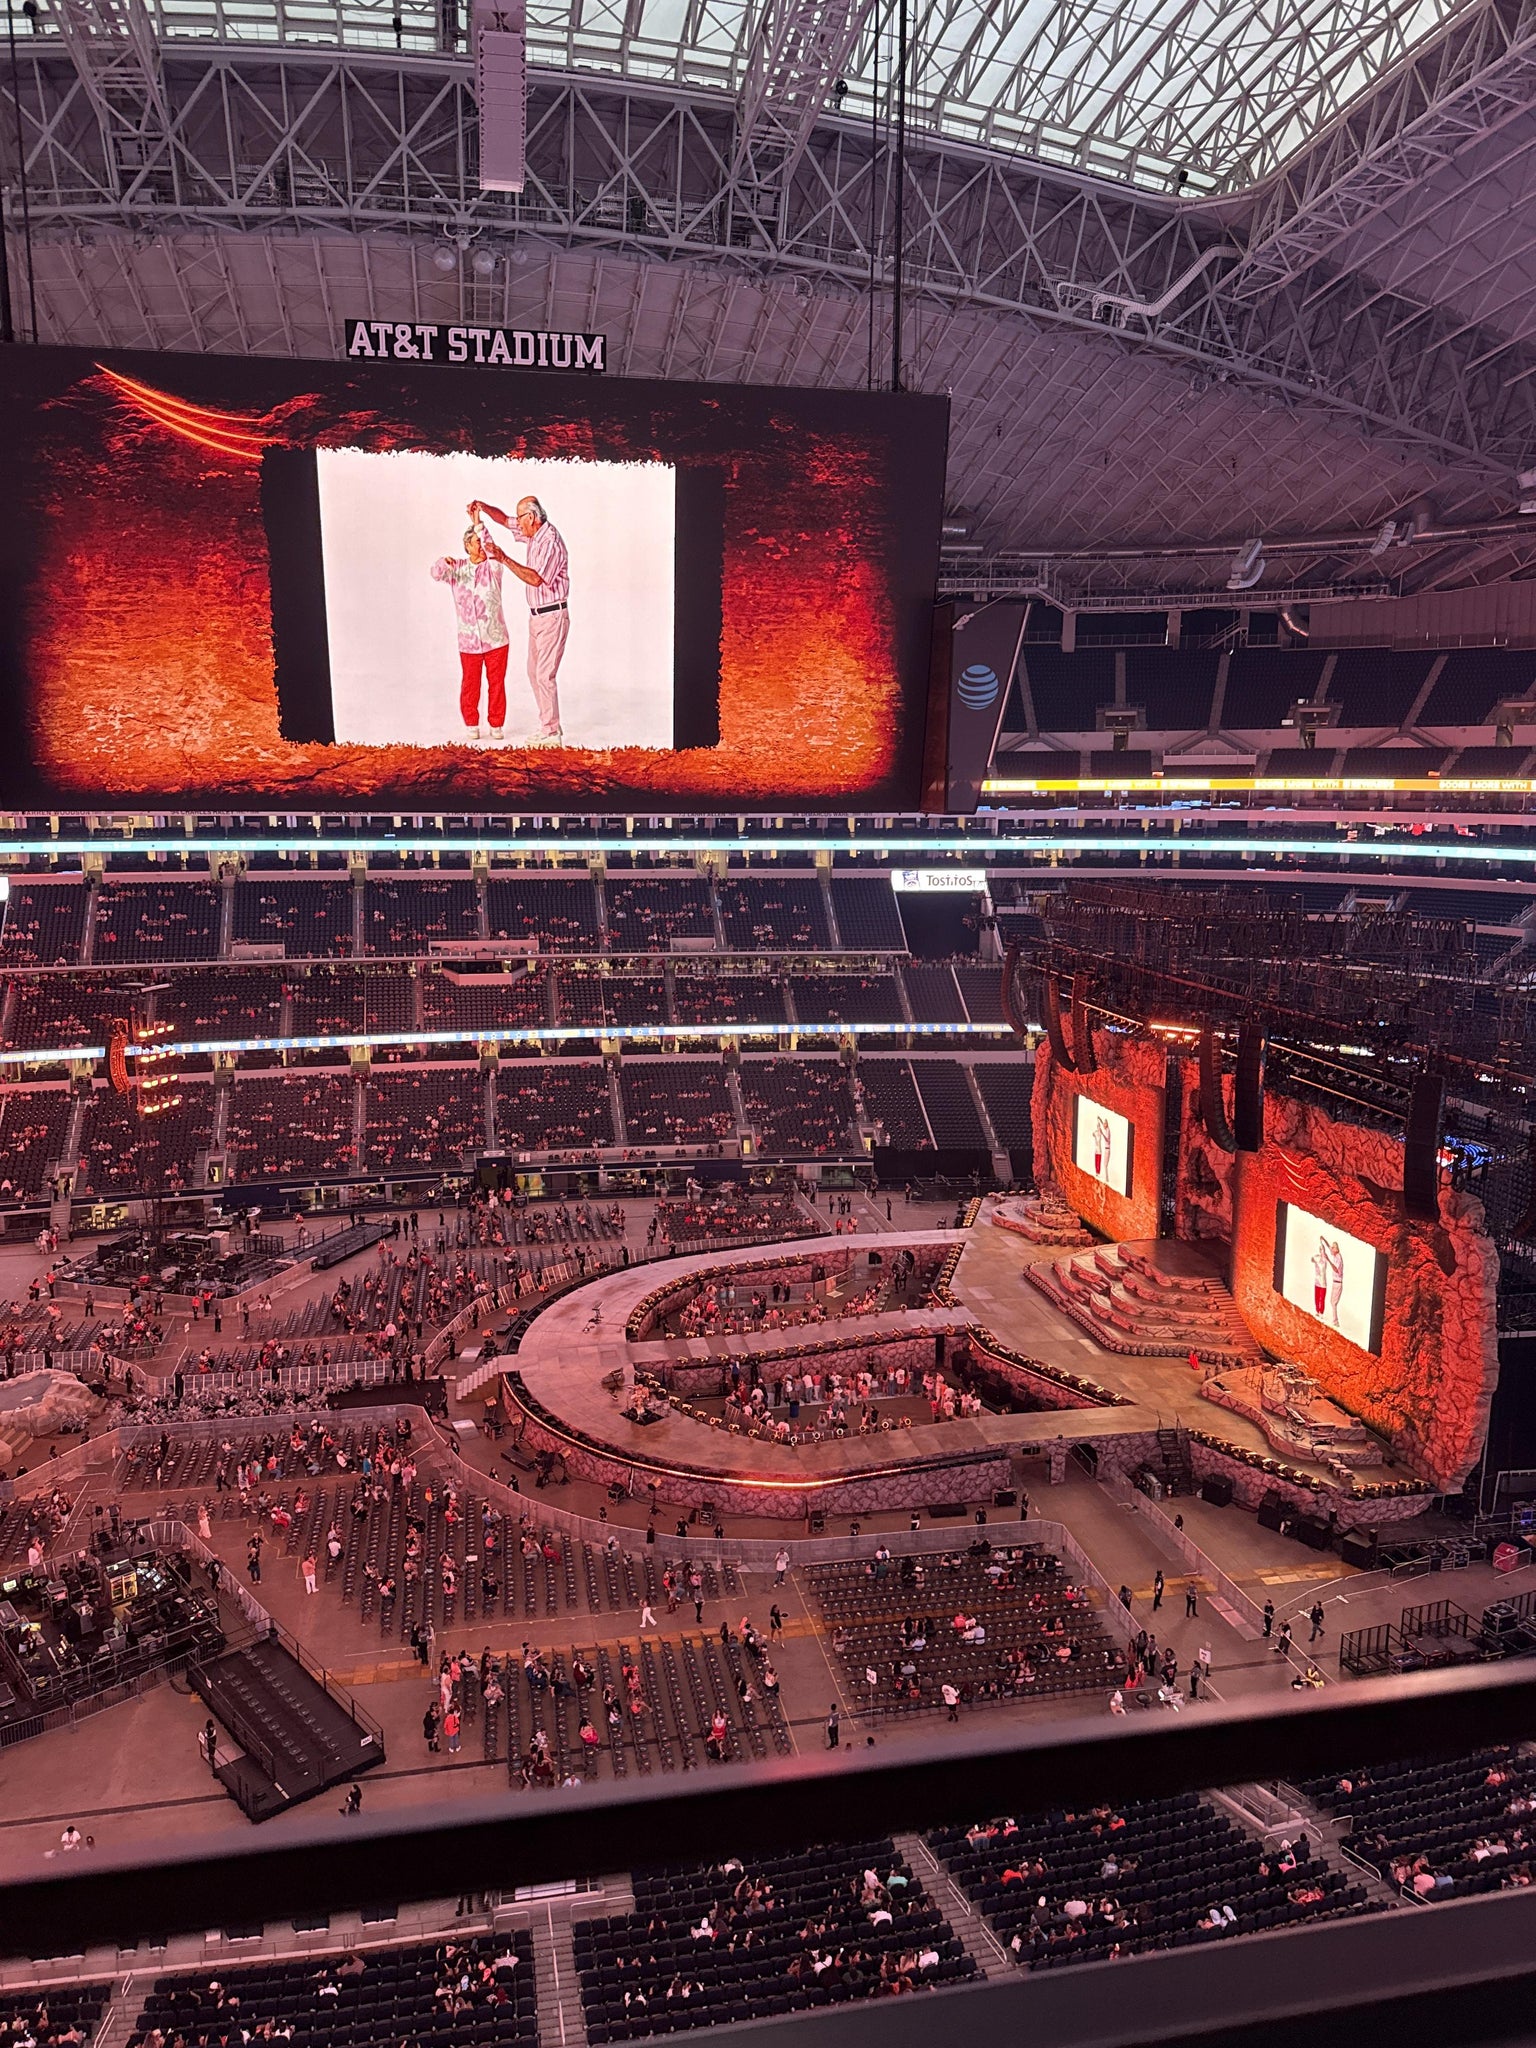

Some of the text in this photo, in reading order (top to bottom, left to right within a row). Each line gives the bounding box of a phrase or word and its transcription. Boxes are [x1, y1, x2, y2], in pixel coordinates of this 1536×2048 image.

[348, 321, 605, 370] AT&T STADIUM
[926, 874, 973, 887] Tostitos
